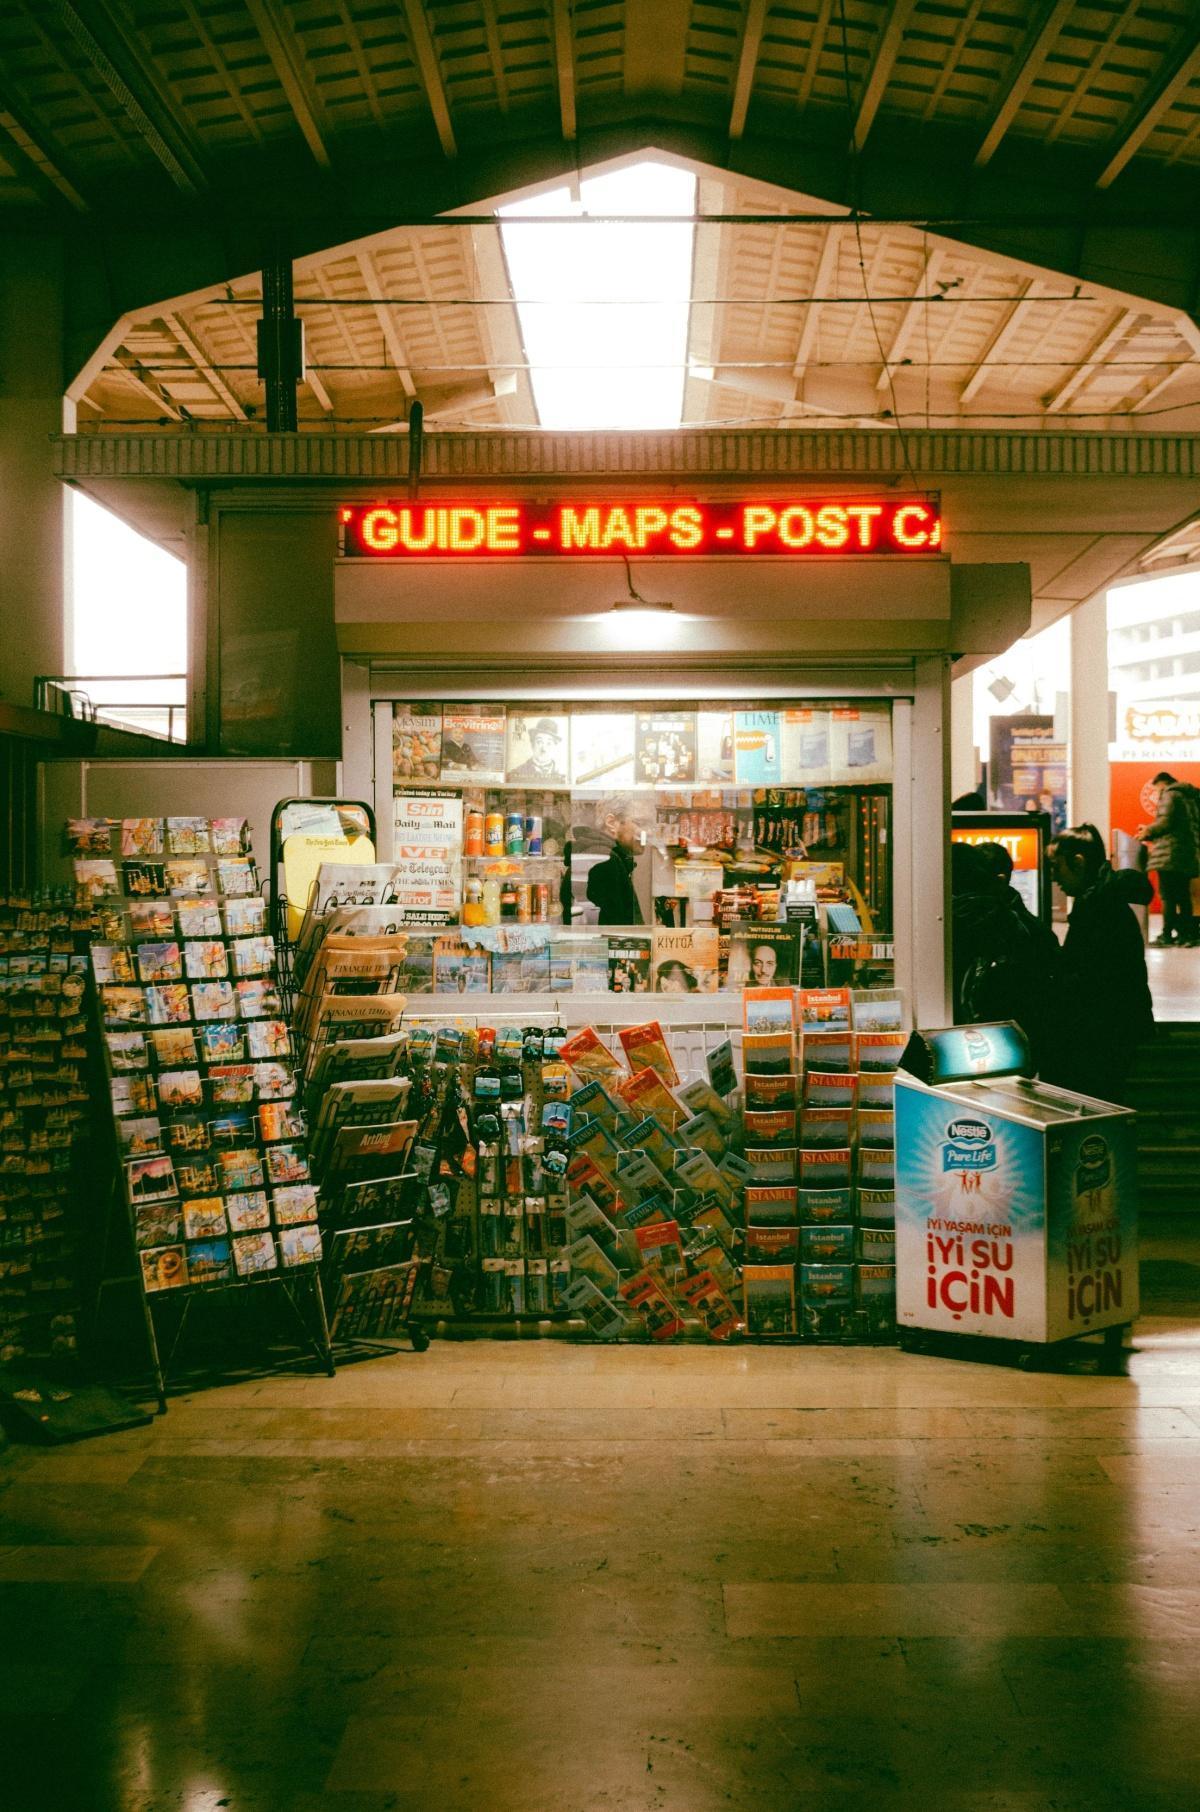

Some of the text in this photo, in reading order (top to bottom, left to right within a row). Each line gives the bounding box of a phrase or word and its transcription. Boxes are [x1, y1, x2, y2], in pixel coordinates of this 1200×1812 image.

[362, 508, 520, 550] GUIDE
[561, 508, 702, 549] MAPS
[744, 507, 882, 548] POST
[892, 506, 941, 547] C
[408, 803, 444, 816] Sun
[395, 820, 456, 830] Daily Mail
[402, 847, 447, 858] VG
[334, 964, 372, 974] FINANCIAL
[802, 1151, 849, 1163] ISTANBUL
[946, 1149, 993, 1163] Pure Life
[748, 1188, 794, 1201] ISTANBUL
[943, 1218, 985, 1236] YAŞAM
[972, 1239, 1014, 1271] SU
[1096, 1233, 1121, 1268] SU
